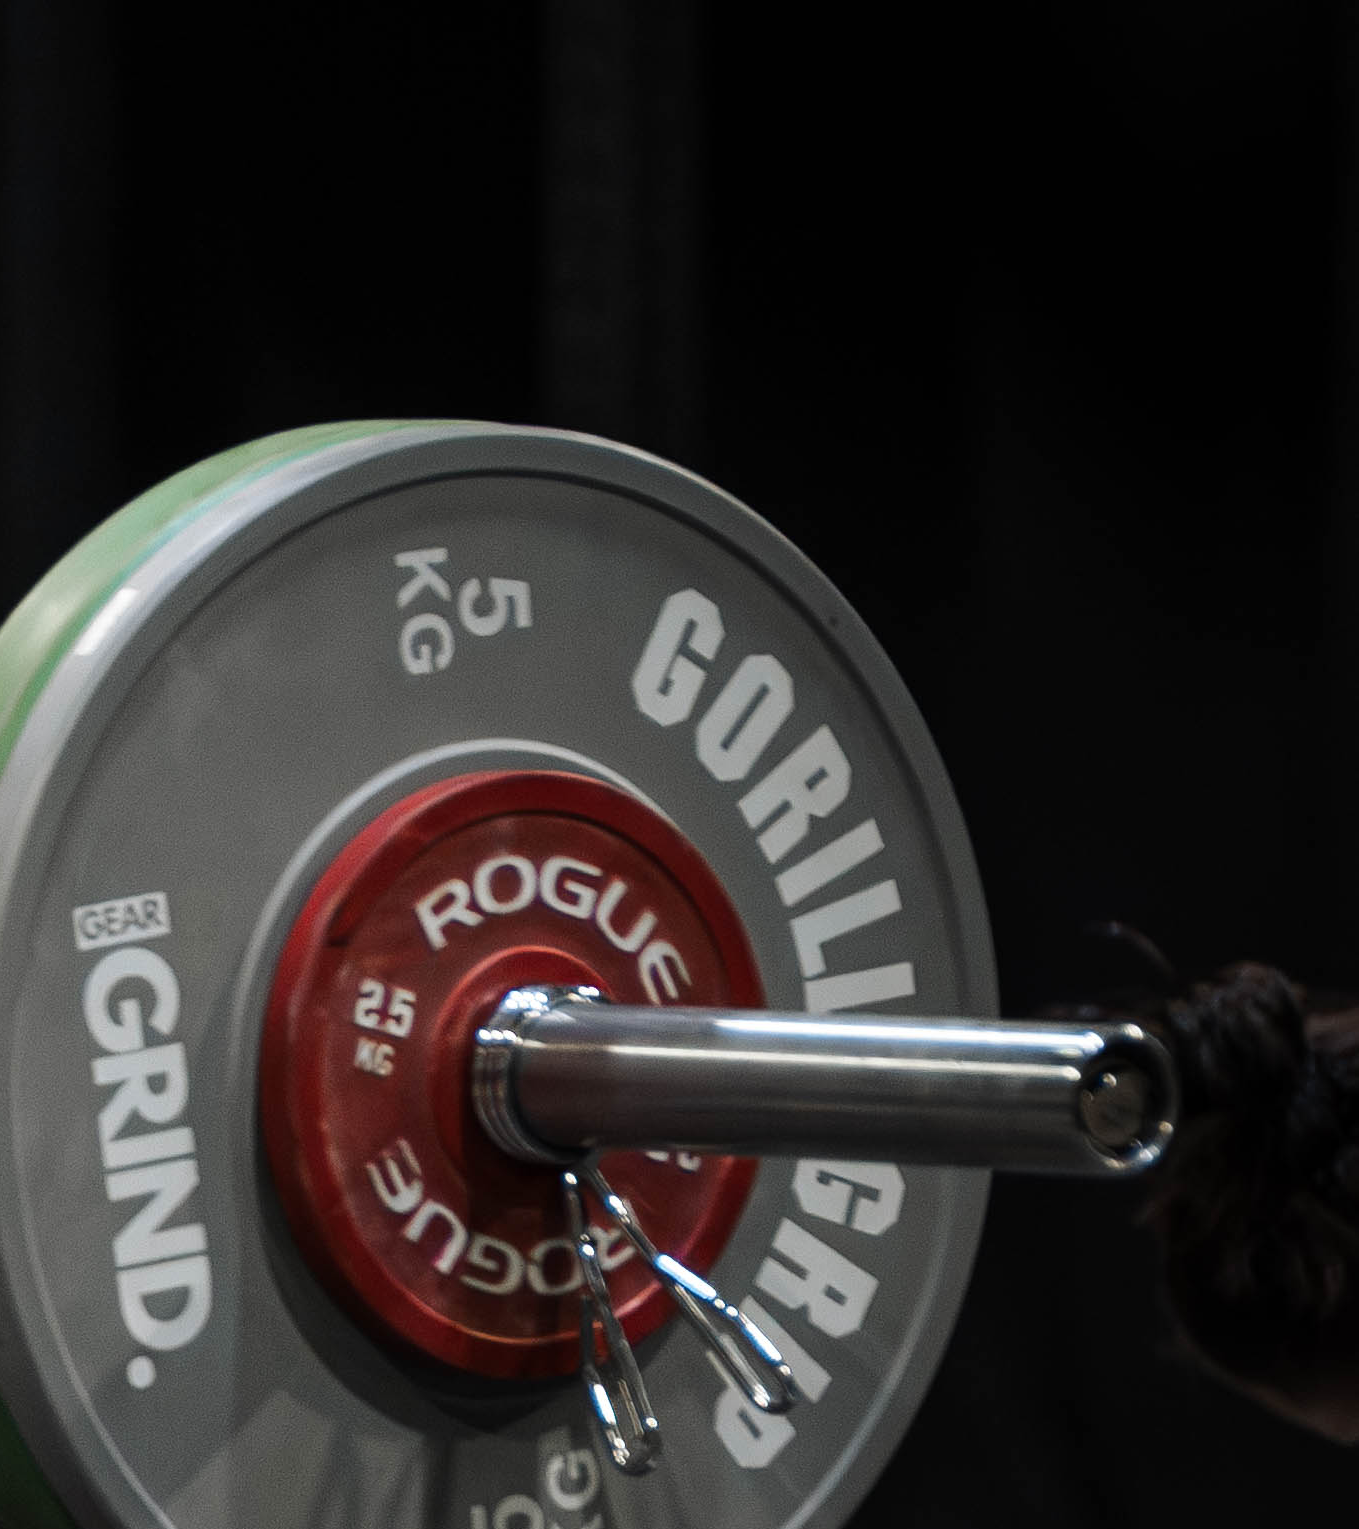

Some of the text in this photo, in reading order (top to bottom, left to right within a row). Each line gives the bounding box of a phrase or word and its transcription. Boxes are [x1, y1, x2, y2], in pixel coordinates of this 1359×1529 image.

[393, 547, 455, 675] KG
[457, 576, 532, 637] 5
[82, 897, 163, 941] GEAR
[415, 855, 693, 1006] ROGUE
[353, 1037, 396, 1077] KG
[632, 588, 916, 1469] GORILL GRIP
[84, 947, 213, 1389] GRIND.
[365, 1137, 636, 1296] ROGUE
